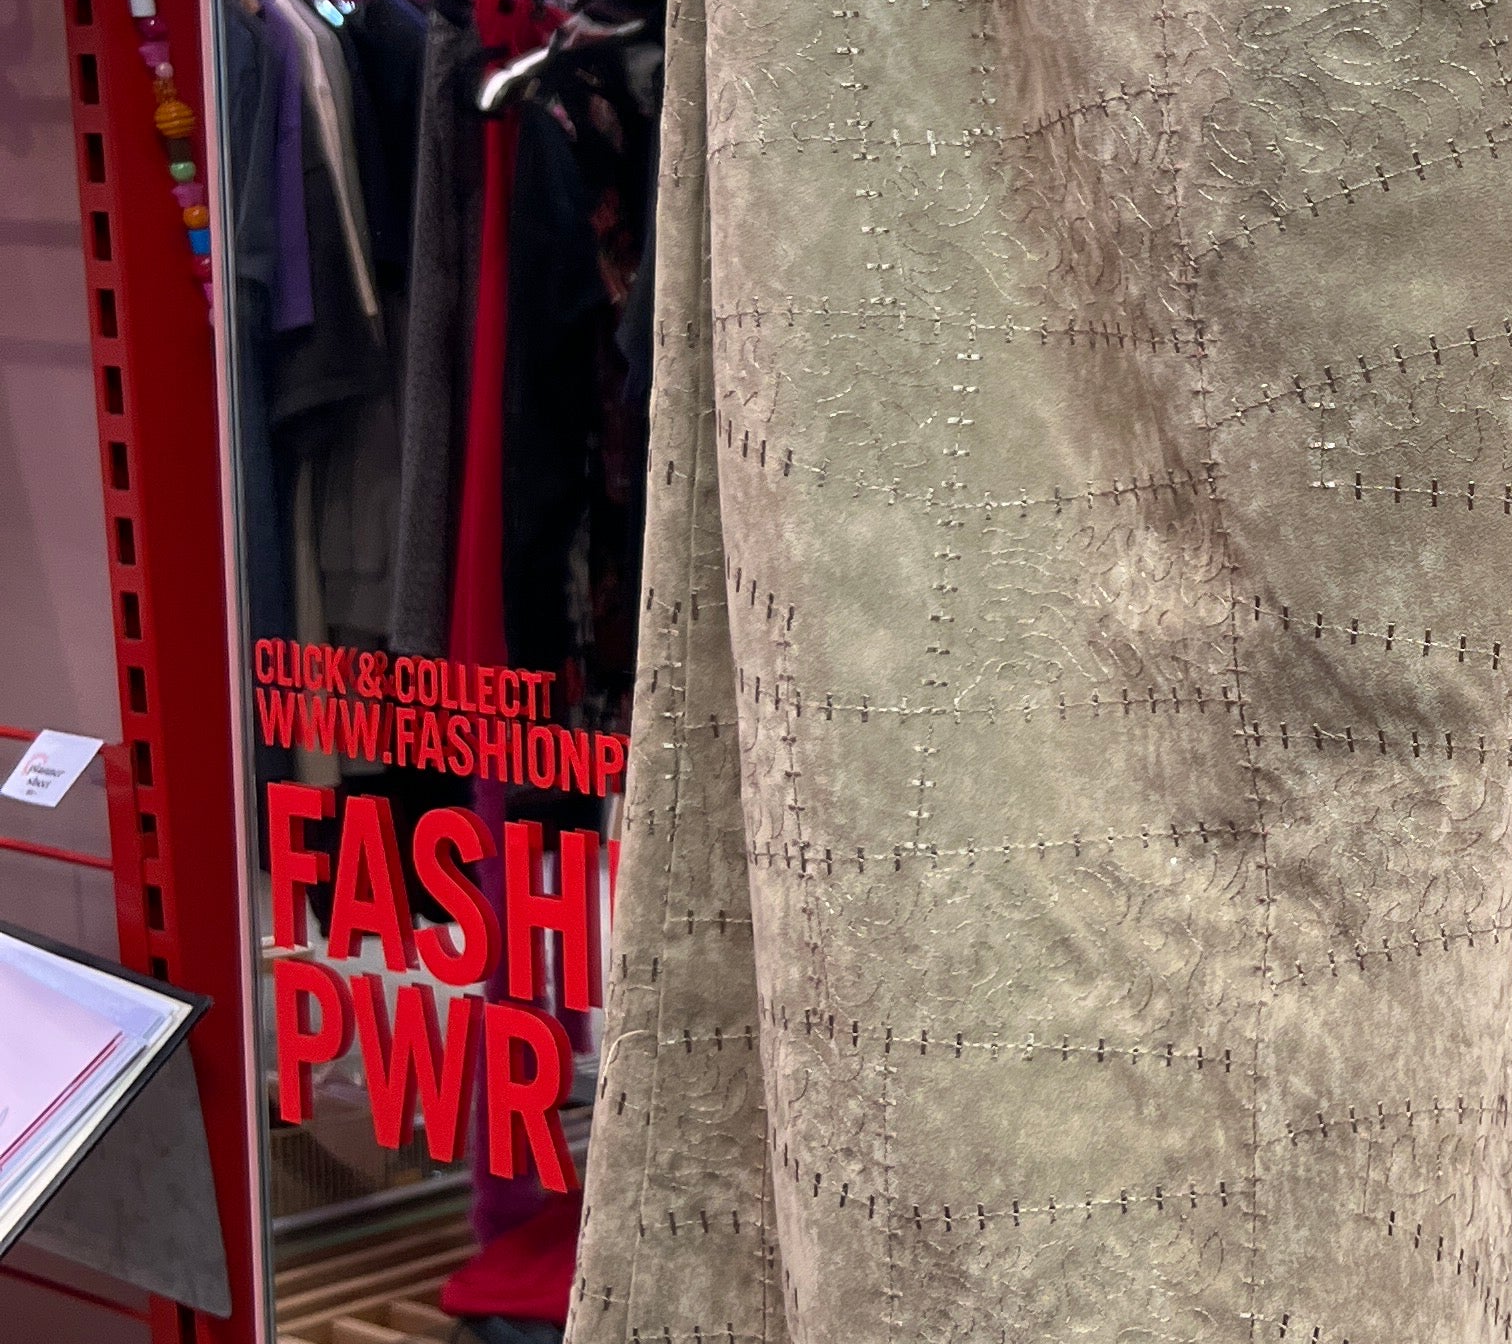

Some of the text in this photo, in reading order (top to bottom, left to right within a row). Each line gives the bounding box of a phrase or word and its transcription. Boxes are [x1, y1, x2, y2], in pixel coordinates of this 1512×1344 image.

[255, 638, 542, 719] CLICK & COLLECT
[256, 688, 627, 798] WWW.FASHIONP
[275, 960, 568, 1194] PWR
